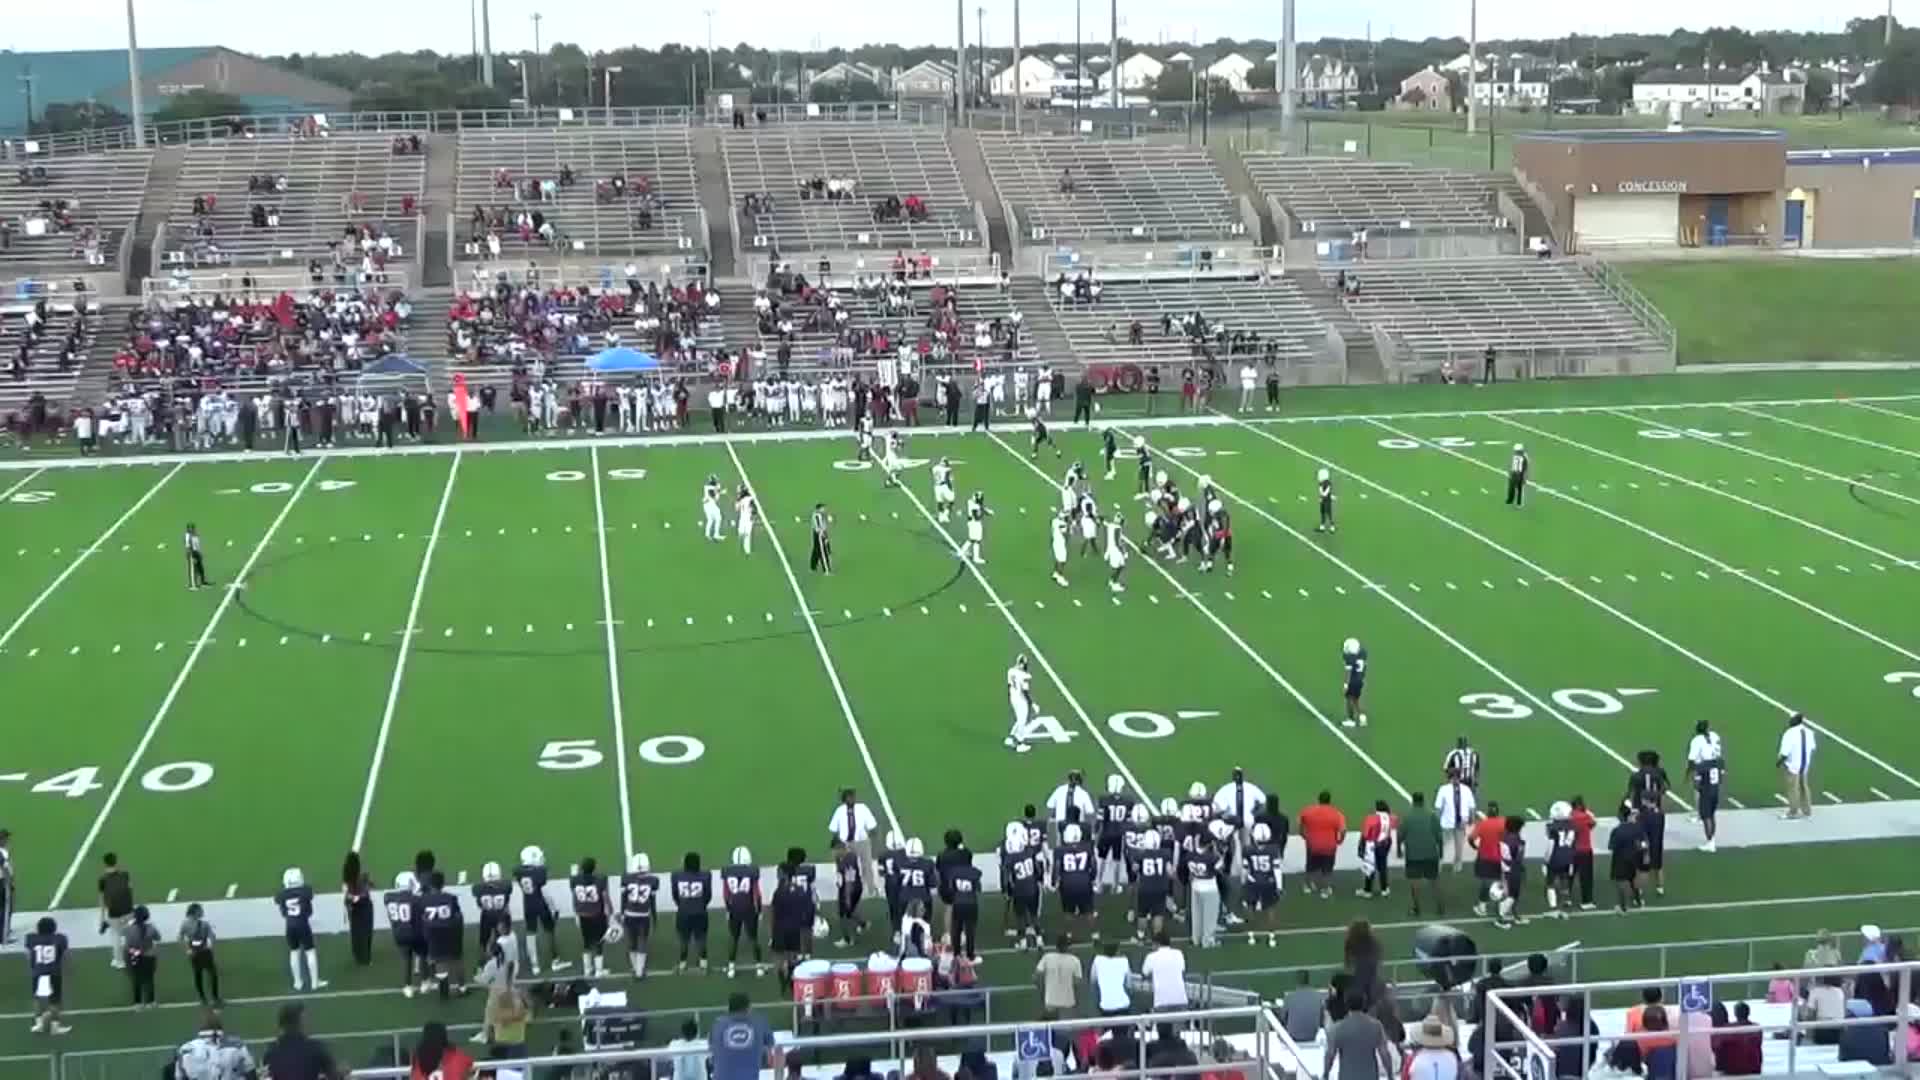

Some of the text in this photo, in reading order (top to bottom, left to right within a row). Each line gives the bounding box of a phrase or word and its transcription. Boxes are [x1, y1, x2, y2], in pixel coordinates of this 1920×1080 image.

[1618, 181, 1688, 193] CONCESSION
[1108, 804, 1127, 822] 10
[1013, 857, 1035, 880] 30
[1142, 857, 1164, 877] 61
[1250, 854, 1271, 873] 15
[900, 868, 926, 888] 76
[286, 898, 301, 916] 5
